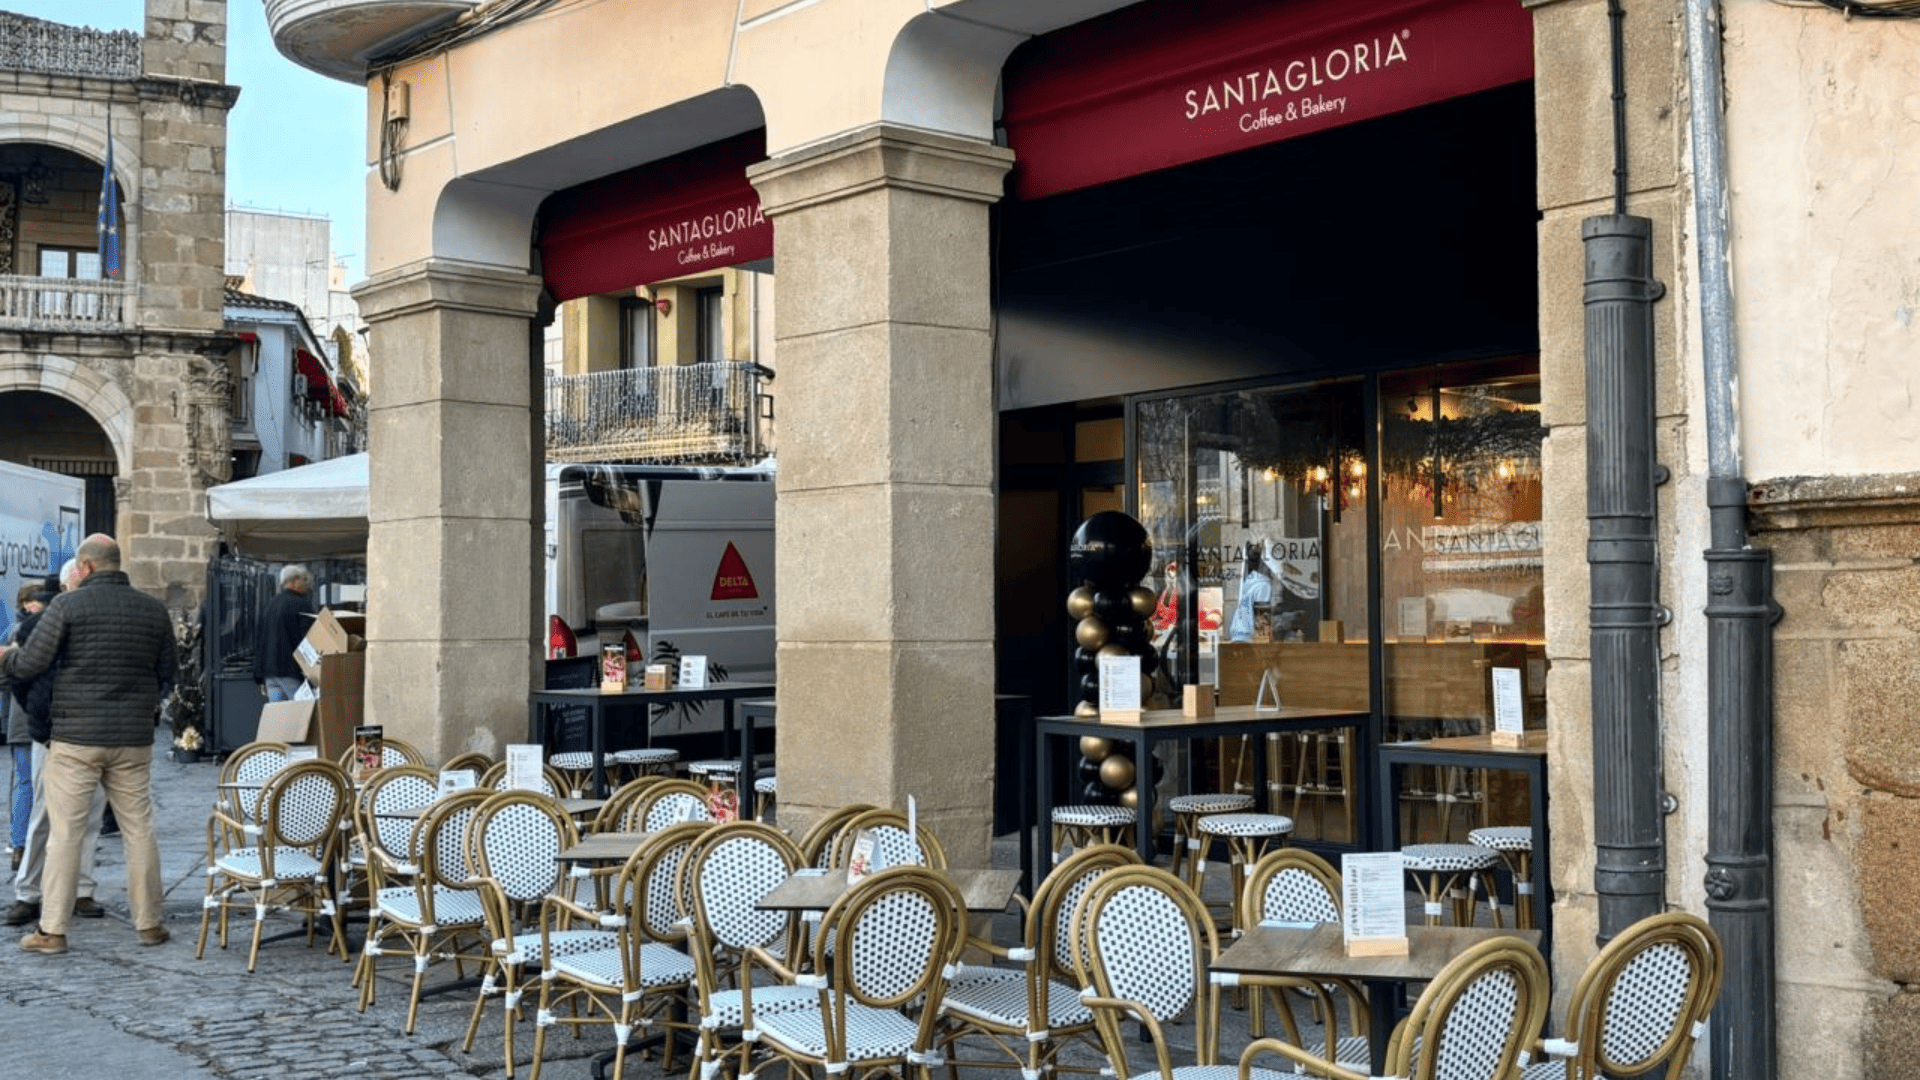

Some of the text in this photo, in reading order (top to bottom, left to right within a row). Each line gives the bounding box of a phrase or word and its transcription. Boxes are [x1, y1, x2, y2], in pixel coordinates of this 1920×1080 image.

[1184, 32, 1408, 119] SANTAGLORIA
[1238, 94, 1347, 132] Coffee & Bakery
[648, 203, 766, 251] SANTAGLORIA
[720, 576, 749, 587] DELTA
